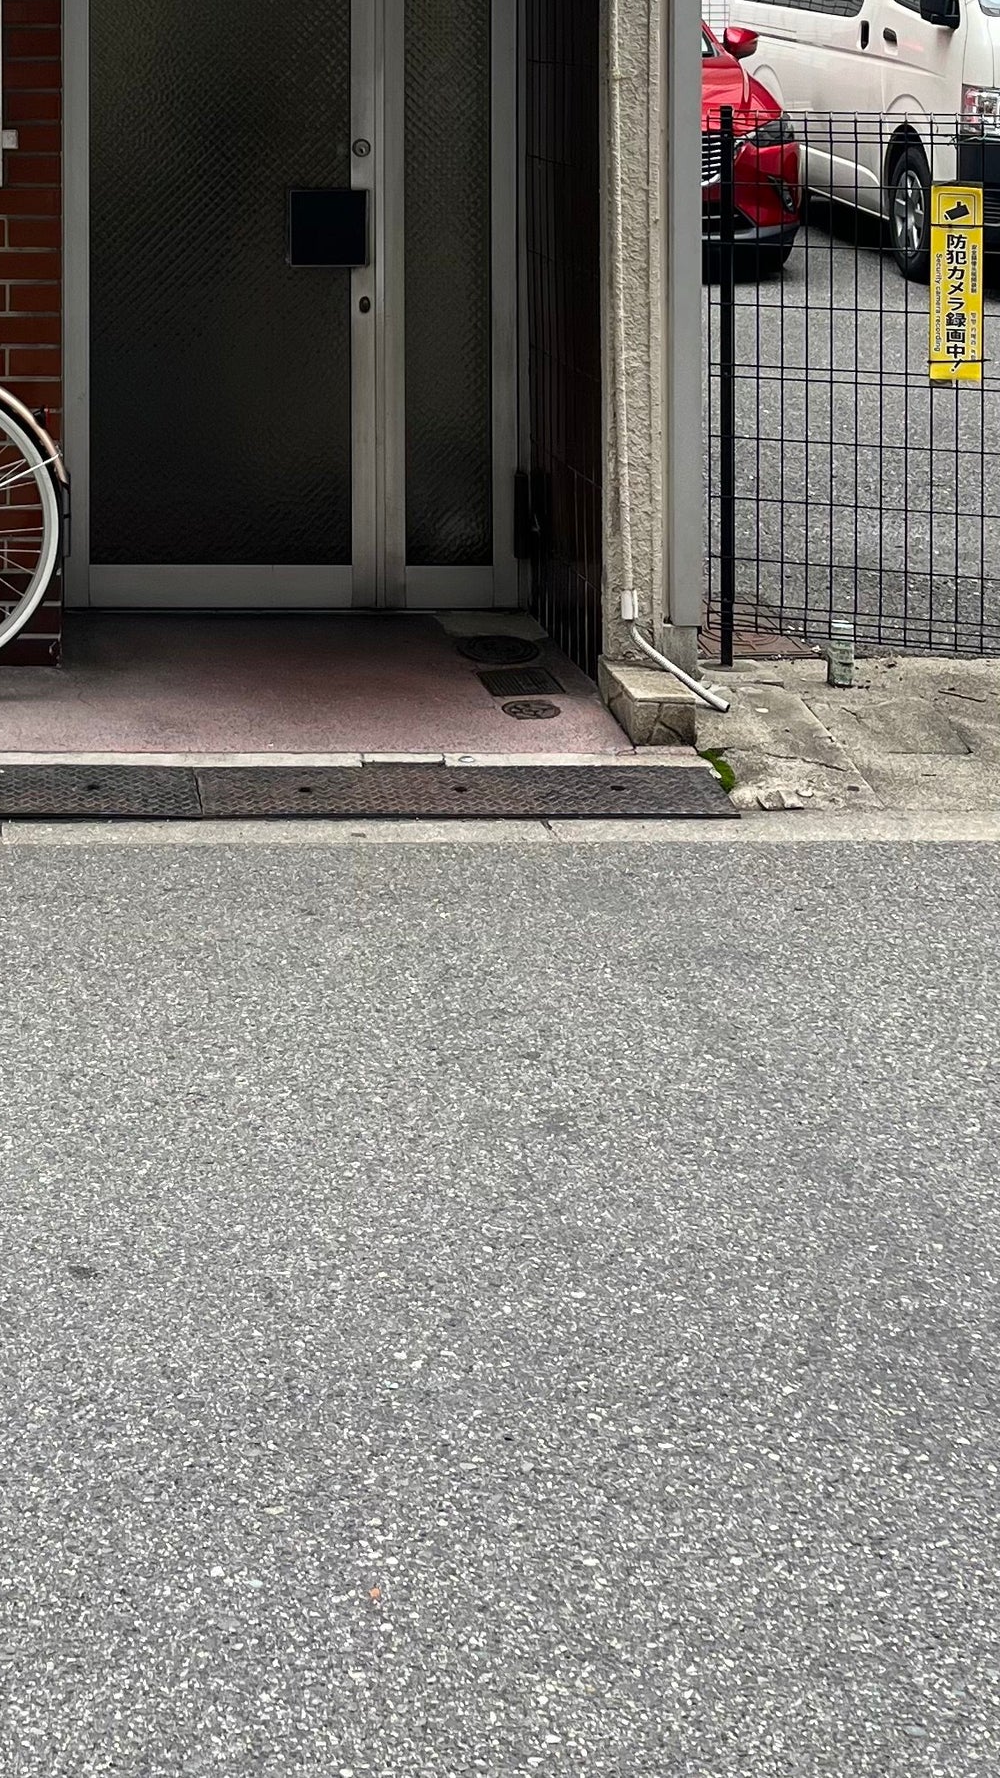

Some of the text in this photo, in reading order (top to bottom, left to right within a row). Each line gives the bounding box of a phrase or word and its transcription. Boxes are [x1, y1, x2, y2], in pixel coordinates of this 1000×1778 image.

[934, 316, 942, 351] recording
[946, 234, 967, 372] 防犯カメラ録画中!
